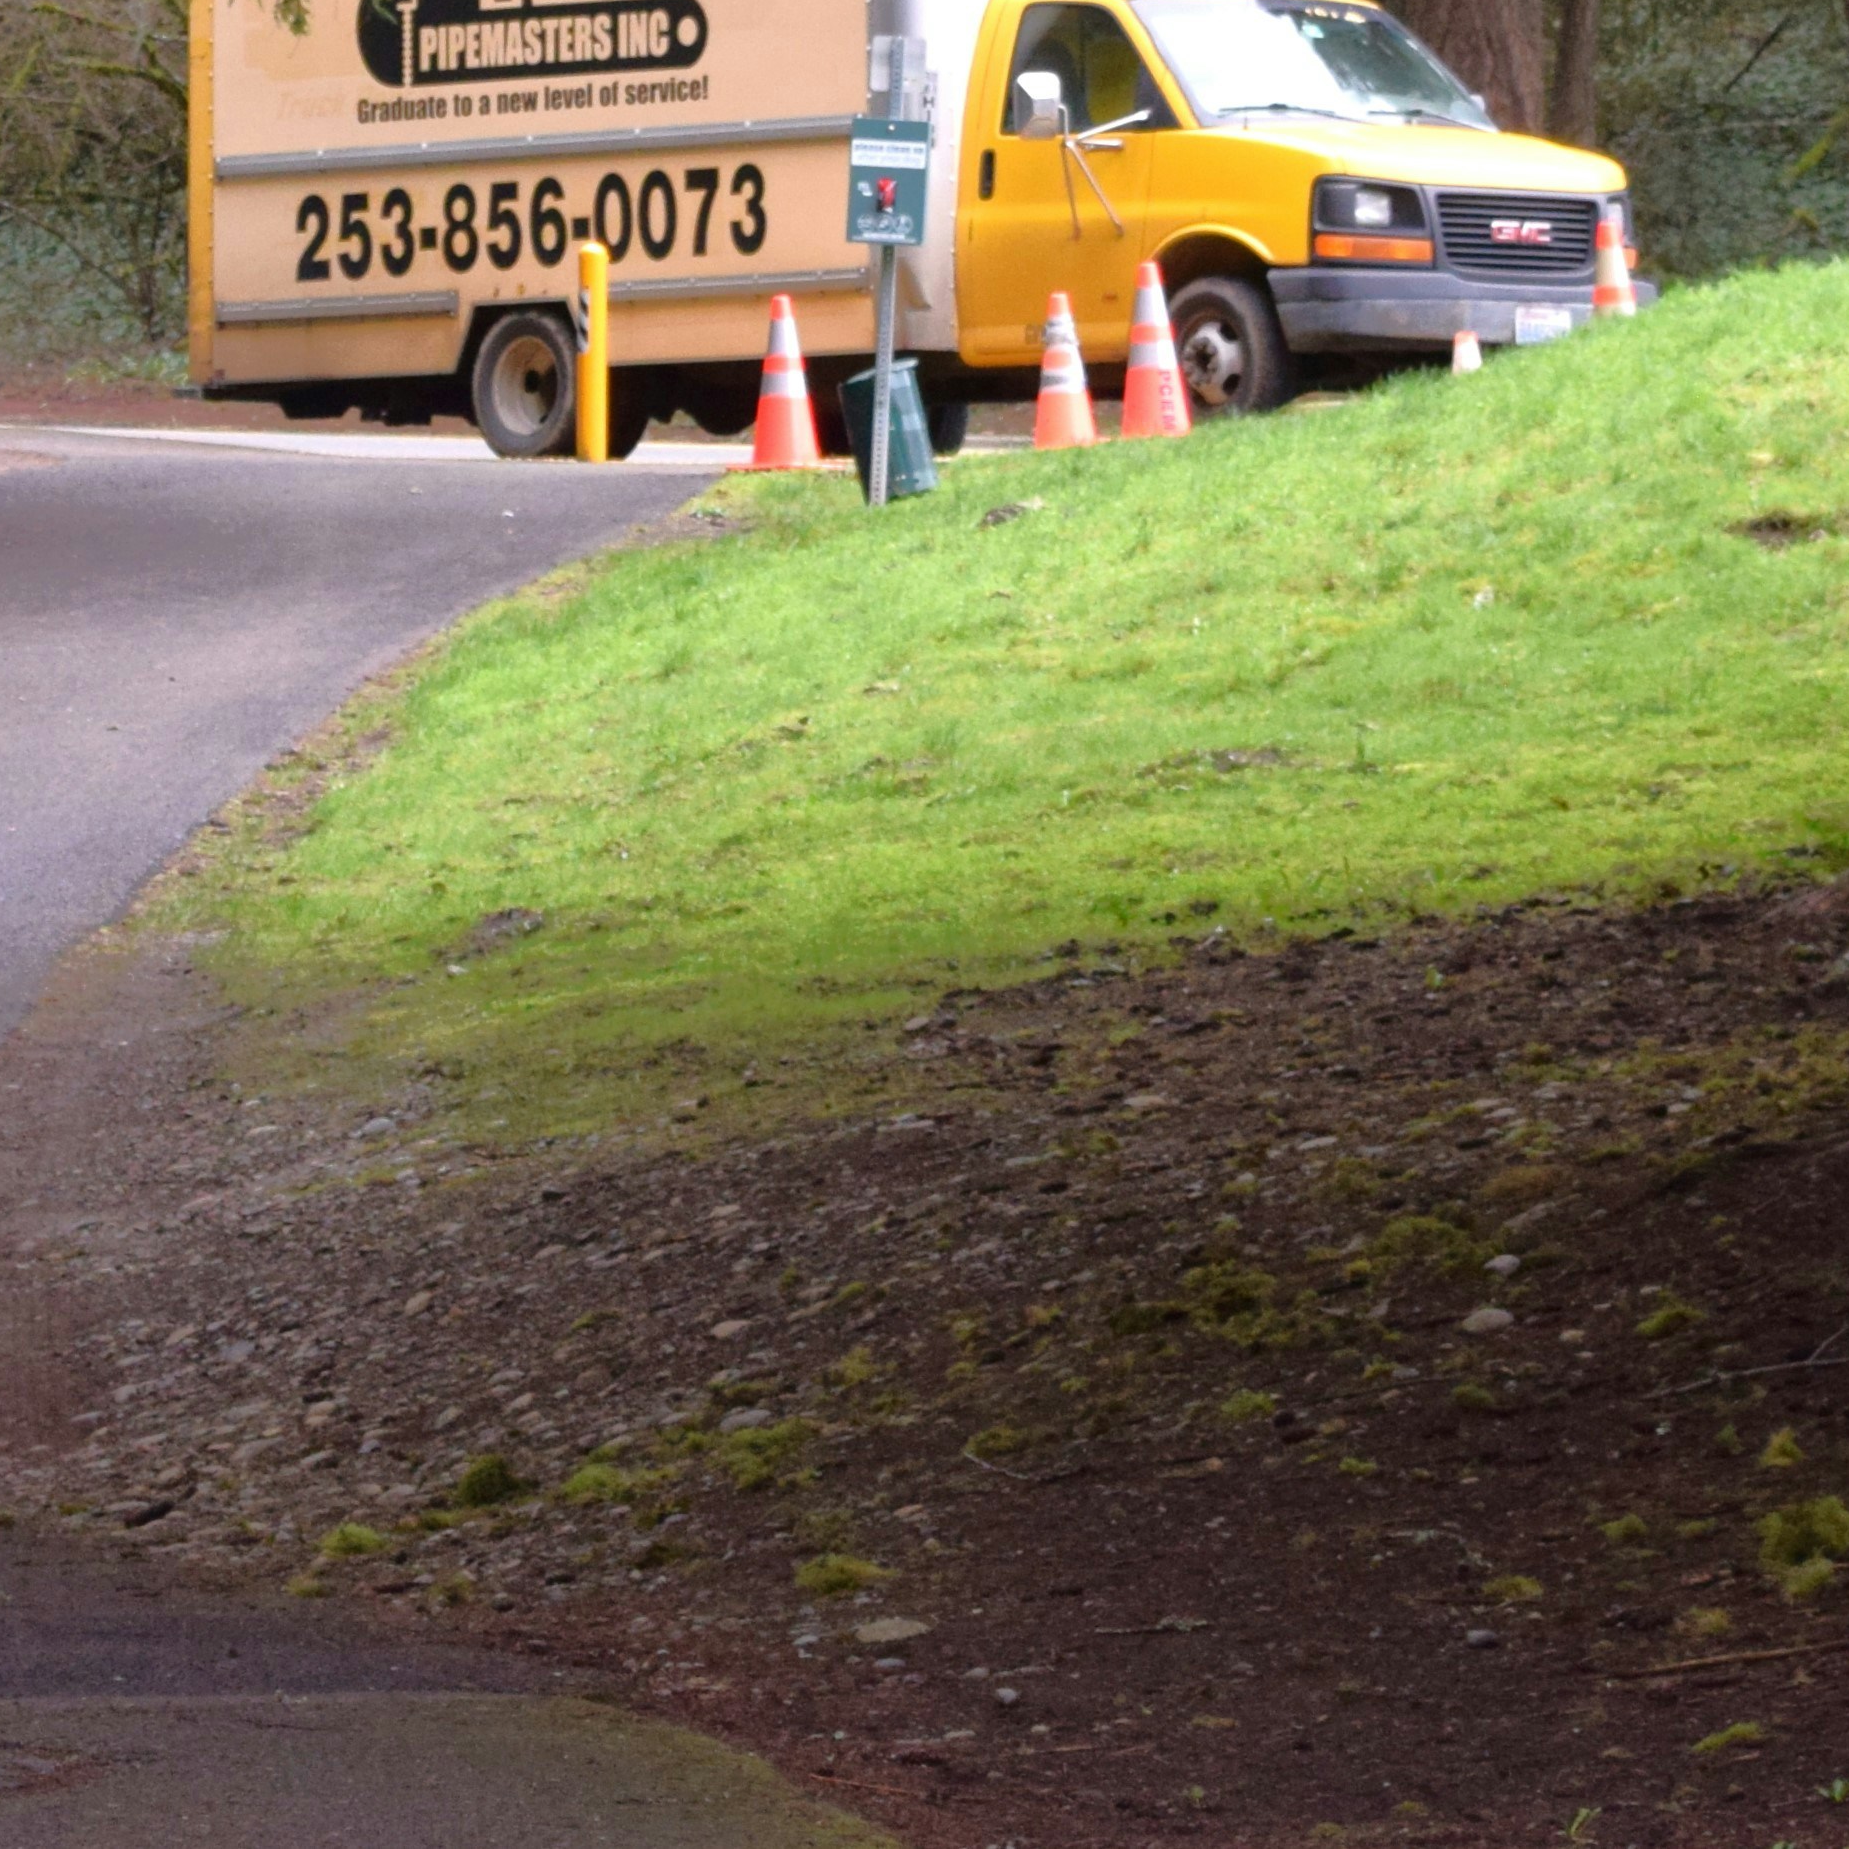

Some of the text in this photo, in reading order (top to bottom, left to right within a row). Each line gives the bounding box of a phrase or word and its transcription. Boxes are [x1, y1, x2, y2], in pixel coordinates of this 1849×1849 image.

[418, 8, 671, 73] PIPEMASTERS INC
[357, 75, 710, 124] Graduate to a new level of service!
[296, 163, 768, 282] 253-856-0073
[1491, 220, 1551, 243] GMC
